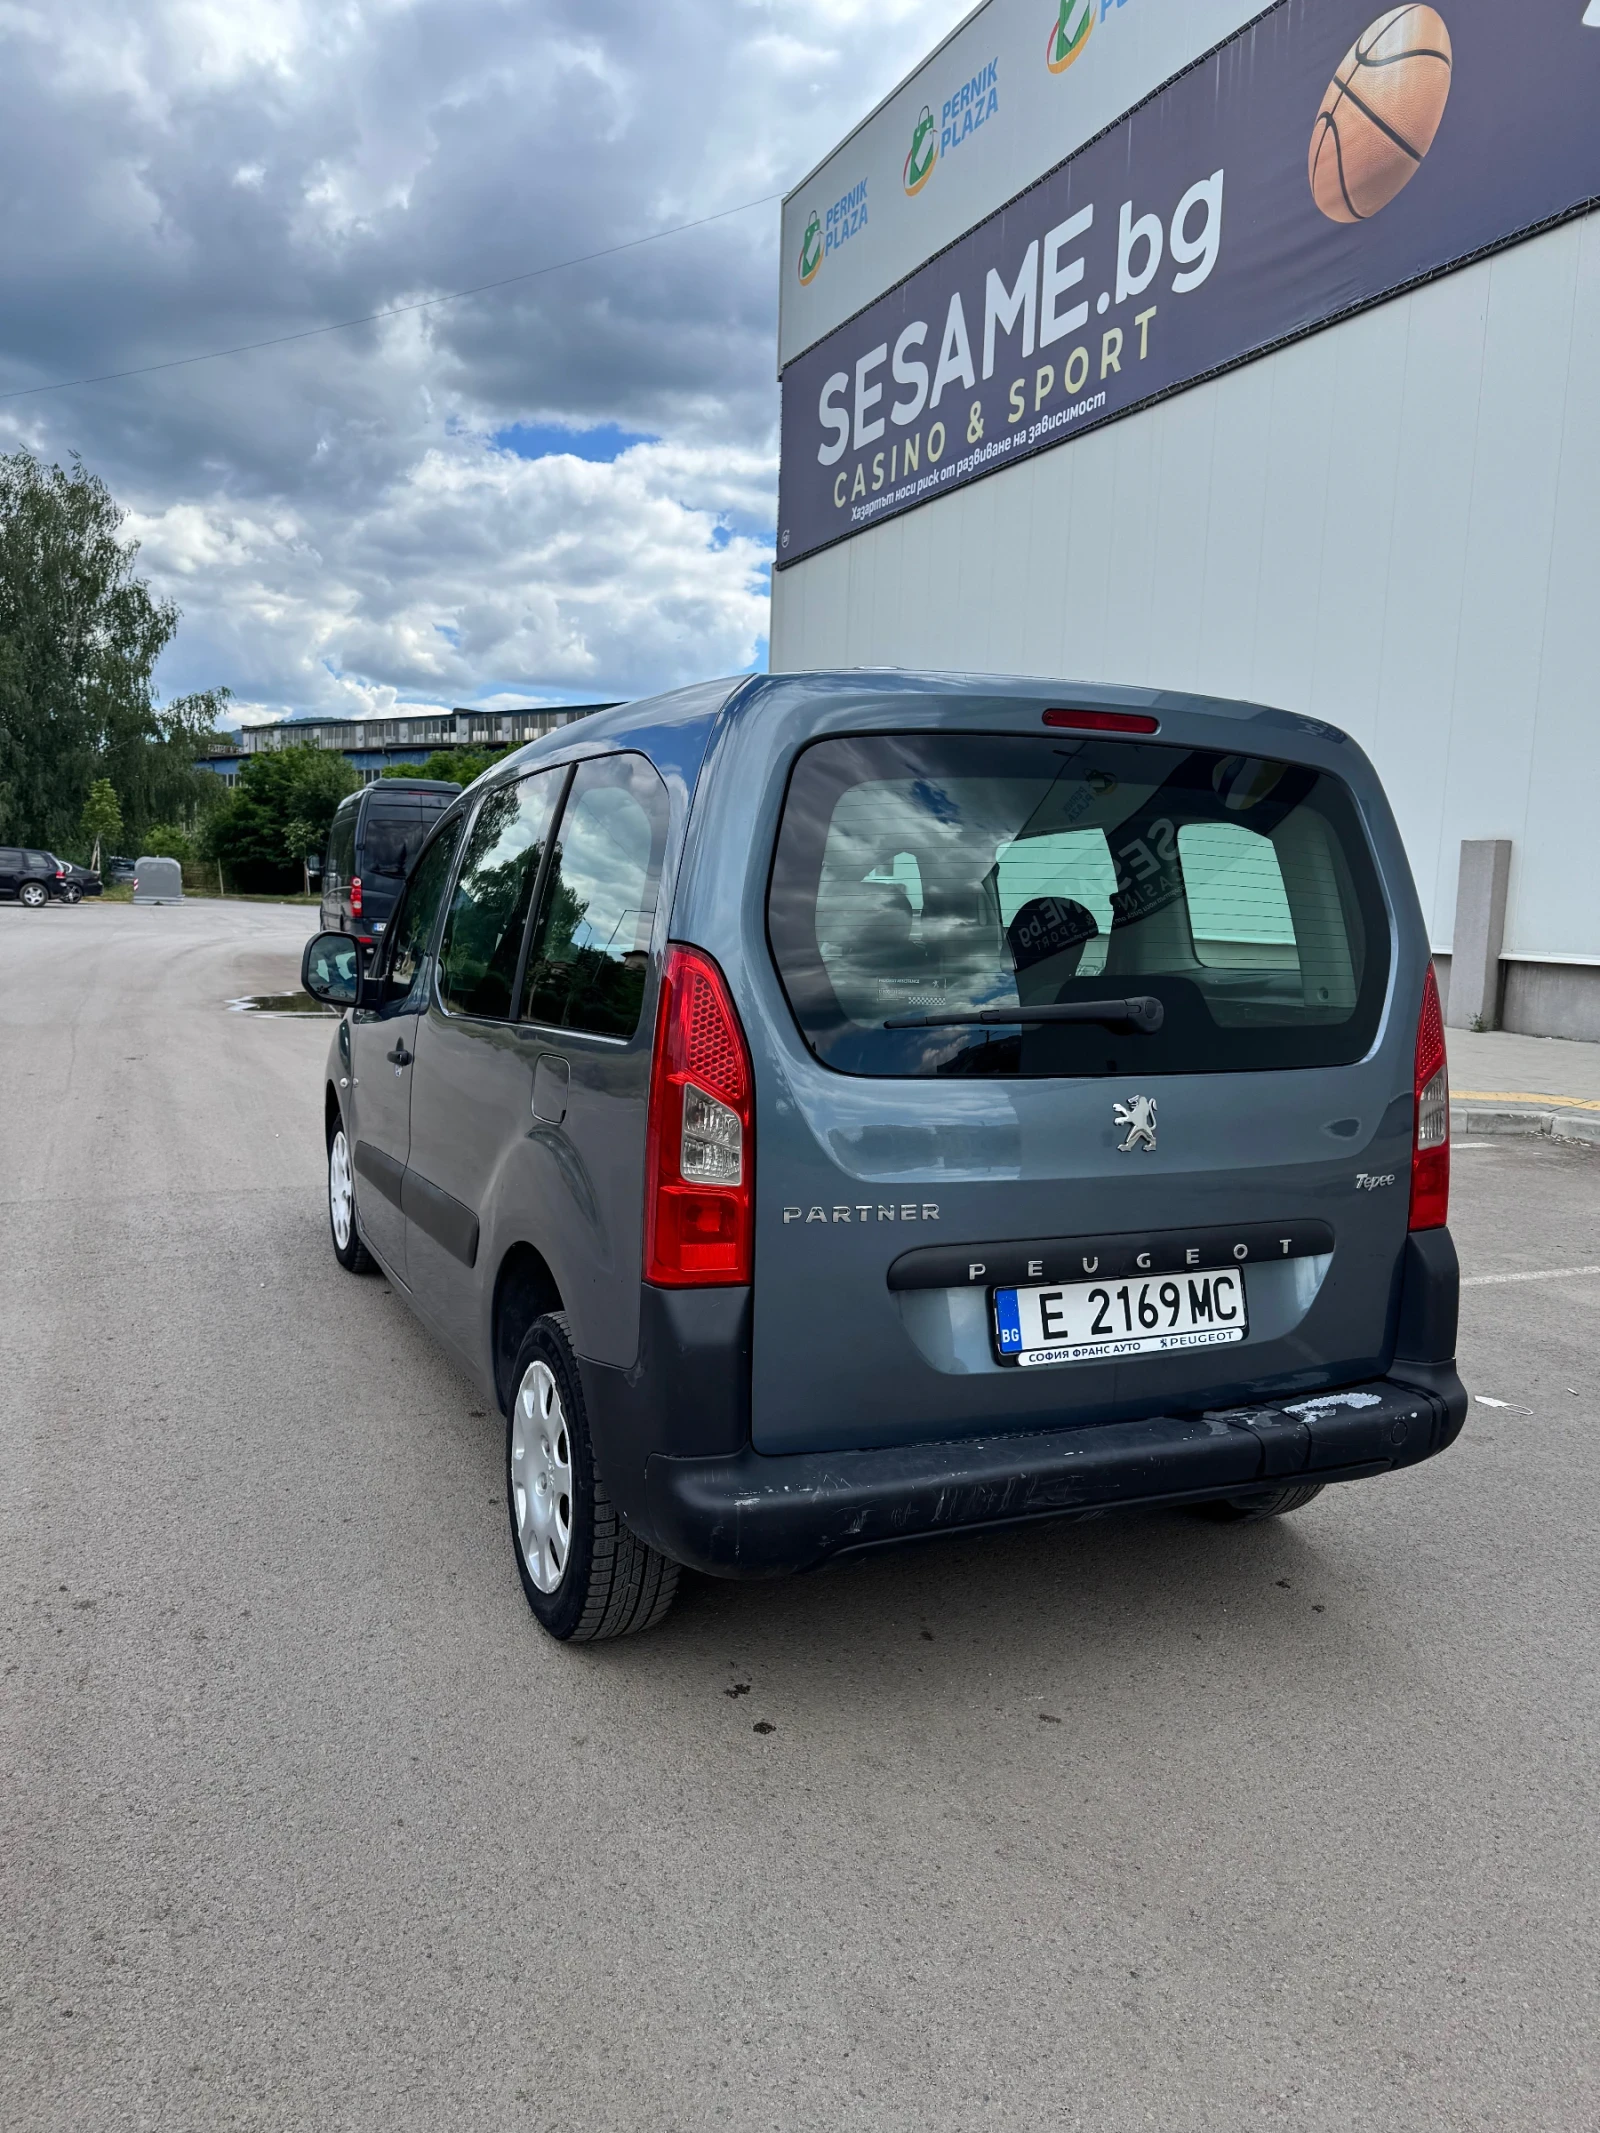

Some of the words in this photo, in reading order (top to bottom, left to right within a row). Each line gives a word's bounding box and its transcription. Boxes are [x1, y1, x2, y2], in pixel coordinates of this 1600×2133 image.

[942, 56, 999, 128] PERNIK
[940, 87, 999, 158] PLAZA
[825, 202, 868, 257] PLAZA
[826, 176, 868, 230] PERNIK
[817, 169, 1225, 466] SESAME.bg
[833, 421, 946, 508] CASINO
[966, 400, 985, 444] &
[1008, 307, 1157, 423] SPORT
[851, 491, 894, 521] Хазартът
[895, 483, 916, 502] носи
[917, 467, 940, 496] риск
[940, 465, 956, 479] от
[956, 437, 1011, 477] развиване
[1013, 430, 1027, 448] на
[1028, 391, 1107, 444] зависимост
[1356, 1173, 1395, 1191] Tepee
[783, 1203, 941, 1225] PARTNER
[968, 1238, 1292, 1281] PEUGEOT
[1002, 1328, 1020, 1343] BG
[1028, 1350, 1069, 1363] СОФИЯ
[1072, 1344, 1110, 1357] ФРАНС
[1113, 1341, 1141, 1353] АУТО
[1170, 1331, 1235, 1347] PEUGEOT
